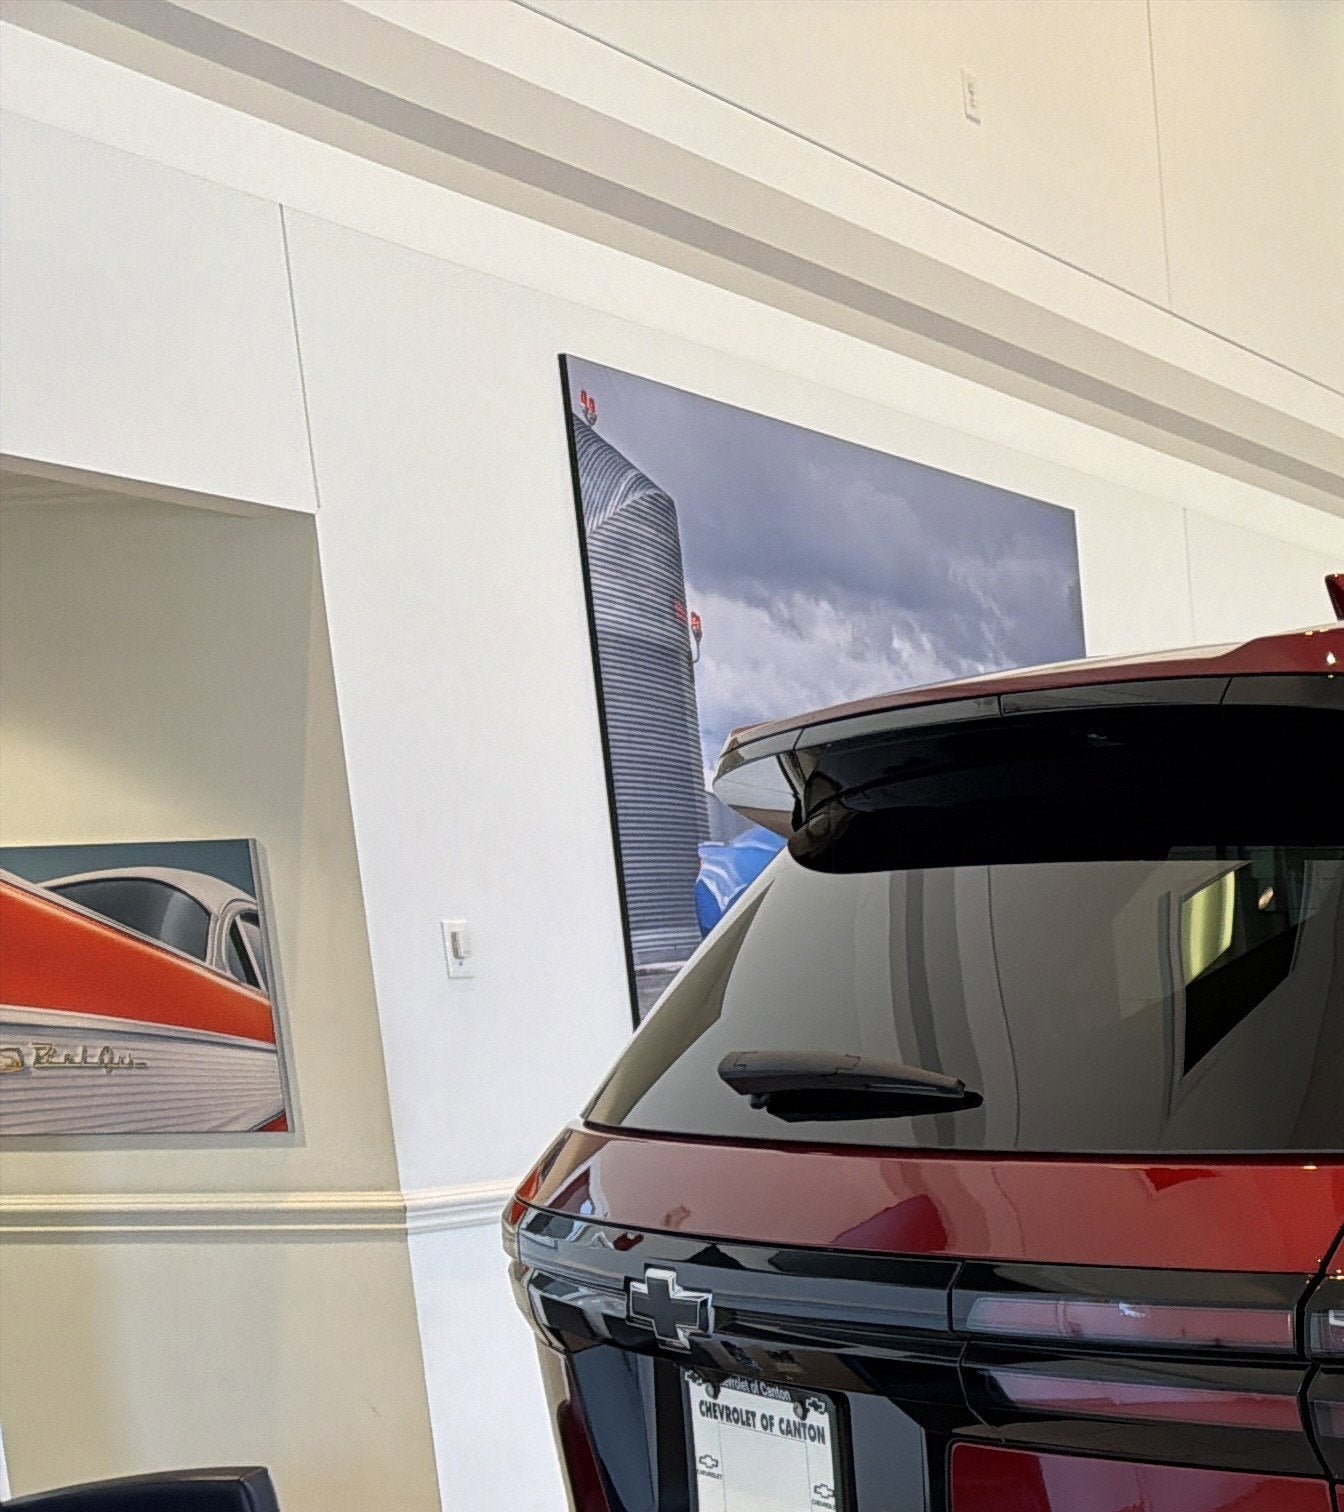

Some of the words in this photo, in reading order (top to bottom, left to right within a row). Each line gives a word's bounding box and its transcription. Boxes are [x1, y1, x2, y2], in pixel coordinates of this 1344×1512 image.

[759, 1381, 791, 1401] Canton
[699, 1399, 757, 1429] CHEVROLET
[760, 1412, 775, 1433] OF
[778, 1416, 826, 1445] CANTON
